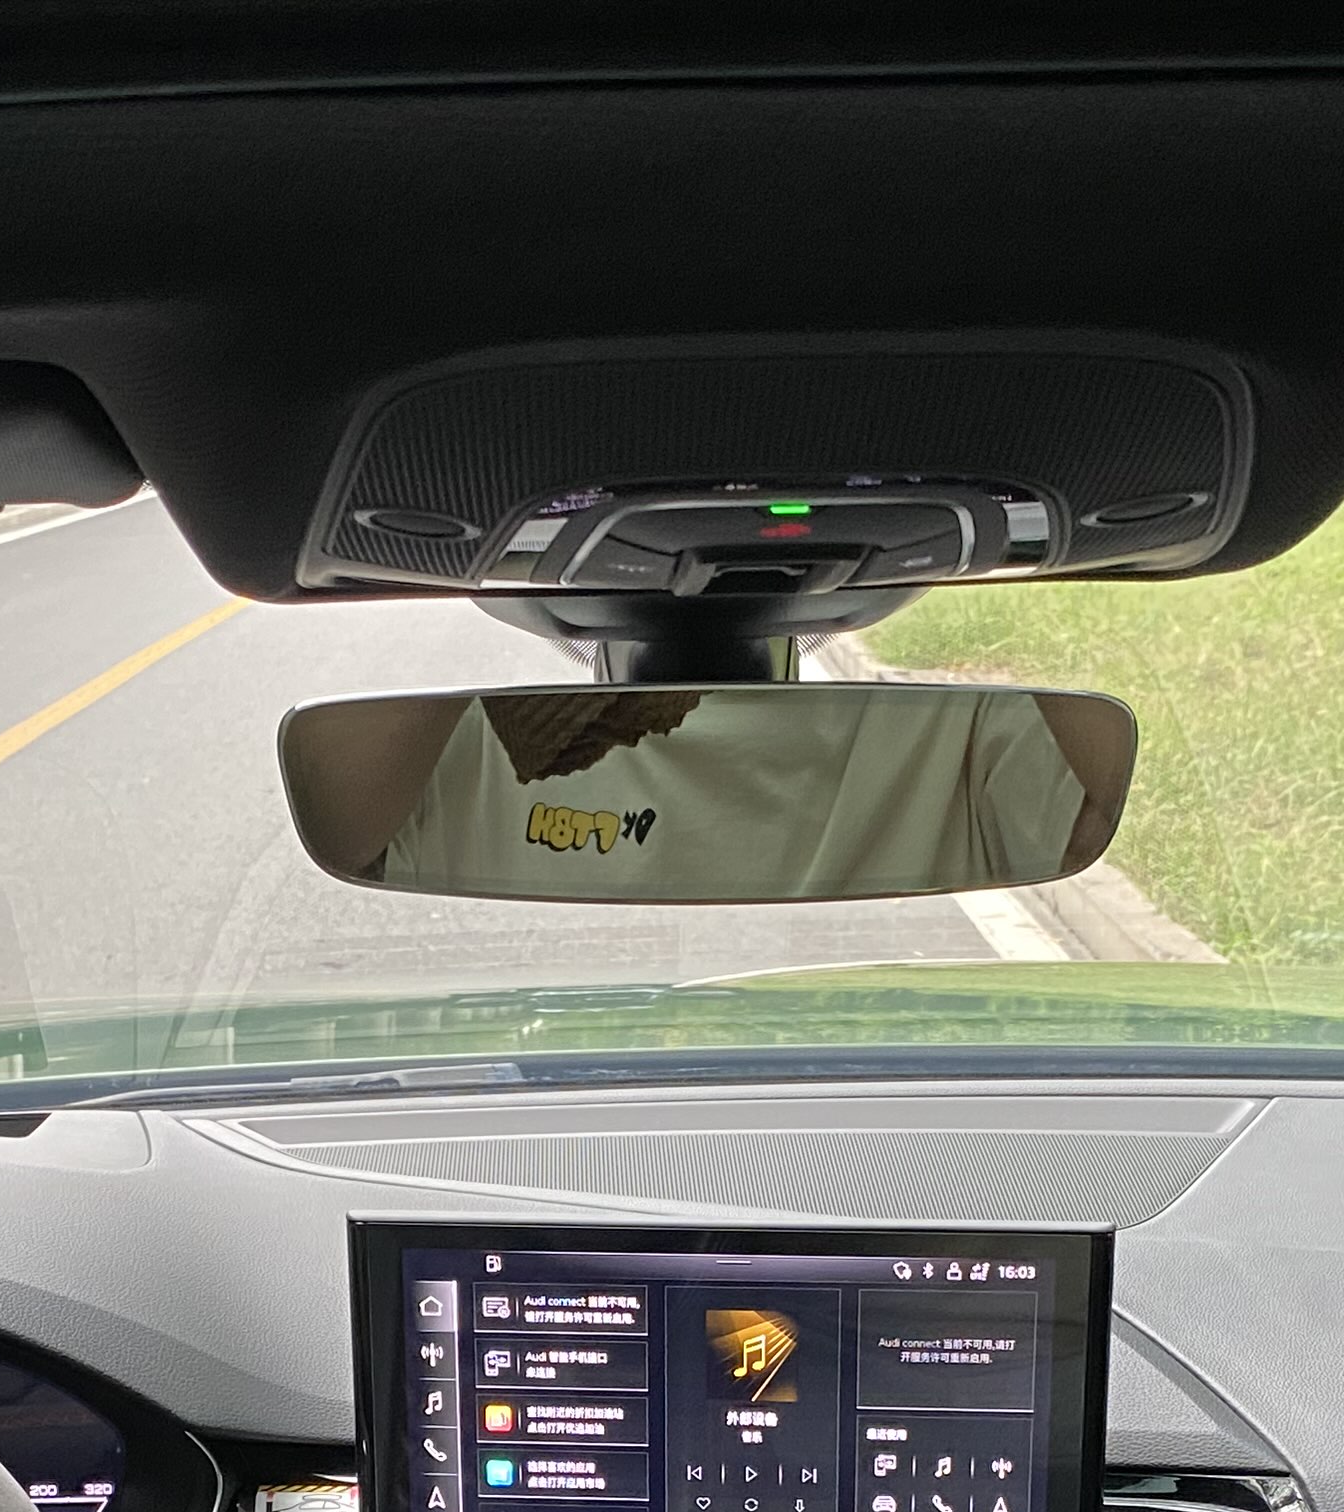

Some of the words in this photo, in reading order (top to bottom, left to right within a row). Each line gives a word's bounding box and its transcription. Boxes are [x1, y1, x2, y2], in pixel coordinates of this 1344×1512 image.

[998, 1265, 1036, 1280] 16:03
[524, 1296, 546, 1307] Audi
[878, 1338, 900, 1348] Audi
[902, 1340, 941, 1349] connect
[525, 1352, 547, 1363] Audi
[726, 1411, 778, 1427] 外部设备
[29, 1484, 57, 1497] 200
